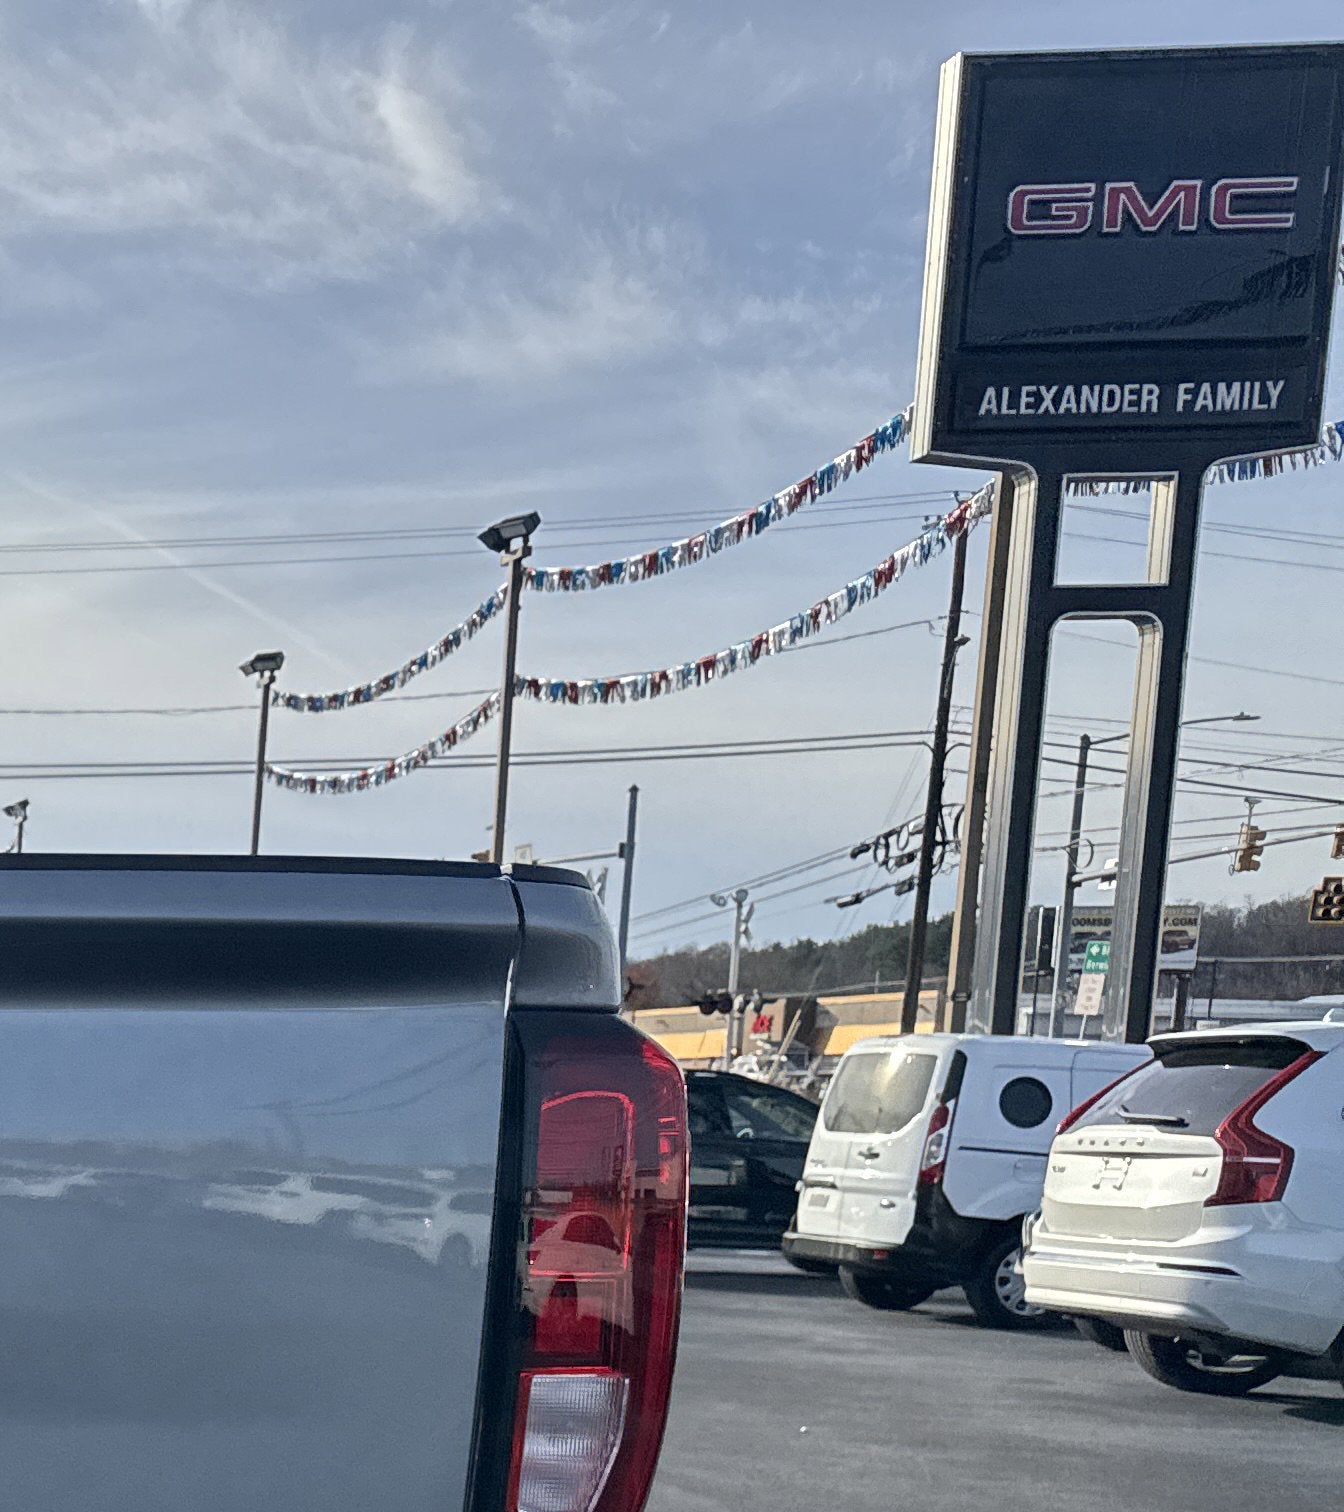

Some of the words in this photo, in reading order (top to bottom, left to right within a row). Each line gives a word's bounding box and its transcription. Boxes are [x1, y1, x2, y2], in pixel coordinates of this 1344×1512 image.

[1008, 177, 1299, 234] GMC
[978, 383, 1160, 415] ALEXANDER
[1176, 379, 1285, 412] FAMILY
